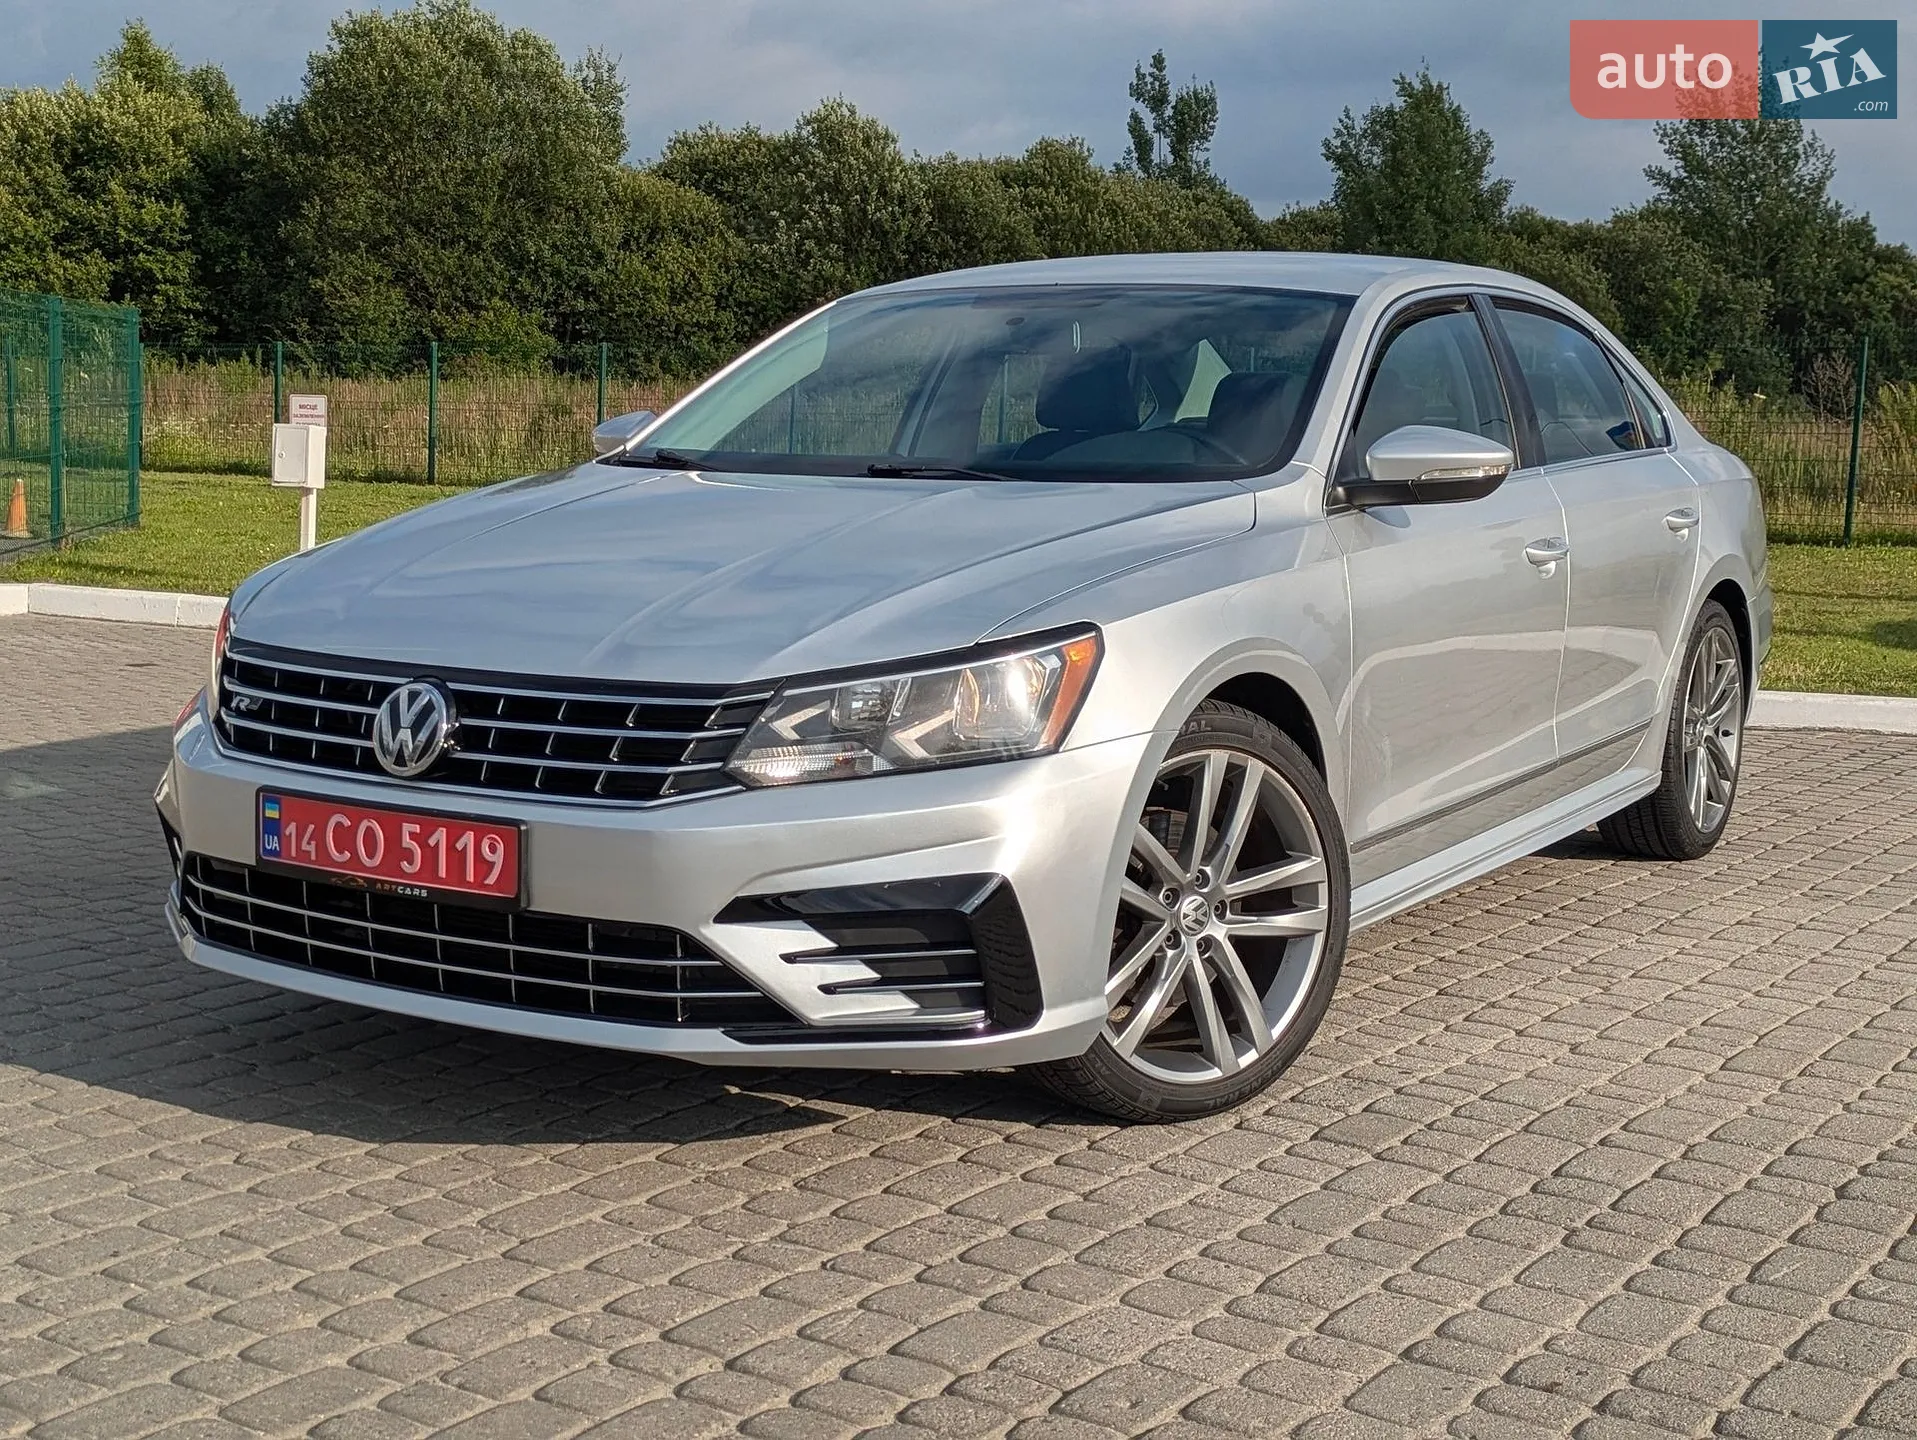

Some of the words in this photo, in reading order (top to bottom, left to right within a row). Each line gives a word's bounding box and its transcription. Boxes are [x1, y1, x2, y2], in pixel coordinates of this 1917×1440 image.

[373, 682, 451, 777] VW
[264, 833, 280, 852] UA
[400, 822, 505, 885] 5119
